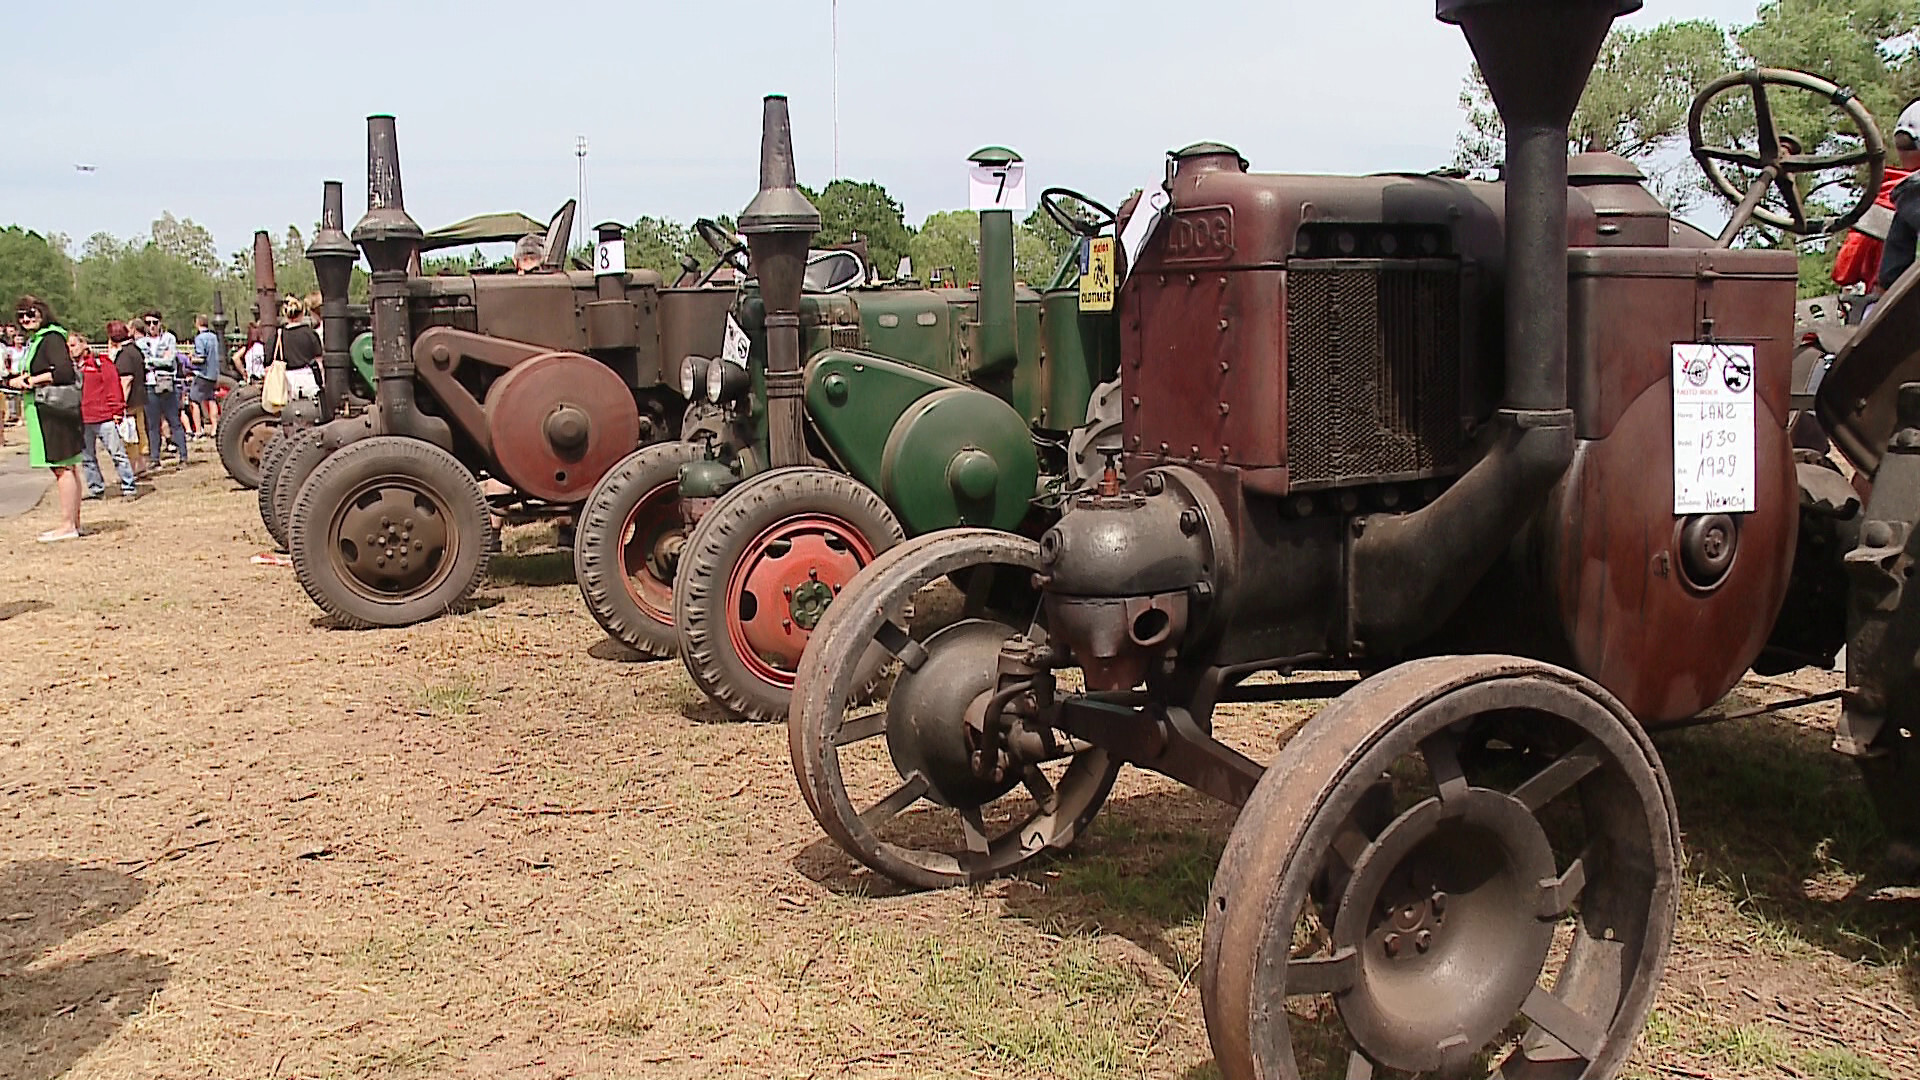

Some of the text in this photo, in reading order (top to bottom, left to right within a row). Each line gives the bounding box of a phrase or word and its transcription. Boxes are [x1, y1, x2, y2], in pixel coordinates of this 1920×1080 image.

[992, 172, 1006, 203] 7
[600, 246, 610, 270] 8
[1081, 291, 1111, 303] OLDTIMER
[1700, 430, 1736, 454] 1530
[1697, 455, 1737, 483] 1929
[1706, 489, 1746, 512] Niemcy
